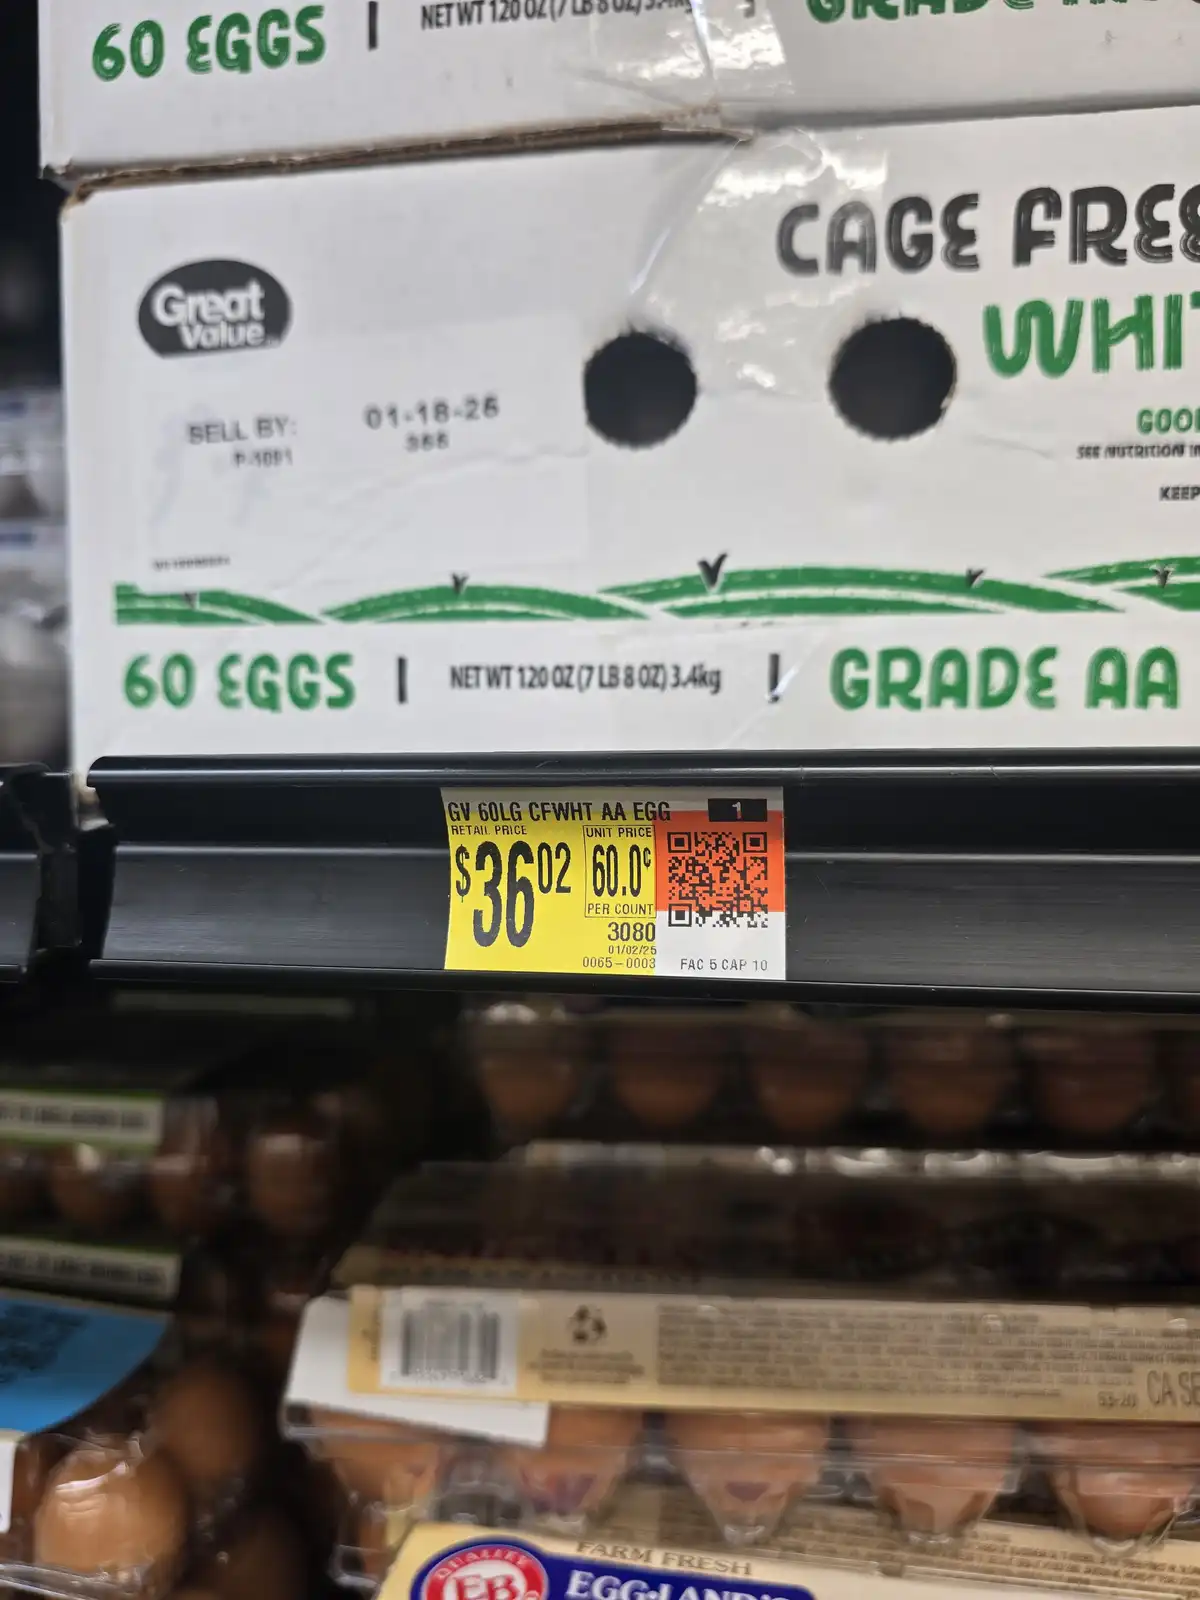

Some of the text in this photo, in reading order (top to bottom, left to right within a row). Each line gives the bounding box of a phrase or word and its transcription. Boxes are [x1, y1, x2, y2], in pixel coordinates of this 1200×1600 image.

[421, 2, 450, 30] NET
[457, 0, 484, 27] WT
[491, 0, 520, 23] 120
[92, 4, 326, 82] 60 EGGS
[777, 192, 980, 277] CAGE
[153, 278, 265, 327] Great
[179, 320, 265, 350] Value
[982, 291, 1200, 378] WHI
[187, 414, 297, 445] SELL BY:
[1076, 444, 1100, 460] SEE
[1104, 443, 1185, 459] NUTRITION
[122, 652, 357, 712] 60 EGGS
[450, 663, 721, 695] NET WT 120 OZ (7 LB 8 OZ) 3.4kg
[830, 645, 1179, 712] GRADE AA
[447, 801, 671, 822] GV 60LG CFWHT AA EGG
[732, 801, 742, 819] 1
[451, 824, 527, 836] RETAIL PRICE
[586, 827, 652, 838] UNIT PRICE
[587, 903, 654, 915] PER COUNT
[607, 921, 656, 942] 3080
[608, 945, 657, 955] 01/02/25
[680, 958, 768, 972] FAC 5 CAP 10
[434, 1549, 528, 1580] QUALITY
[576, 1540, 752, 1576] FARM FRESH
